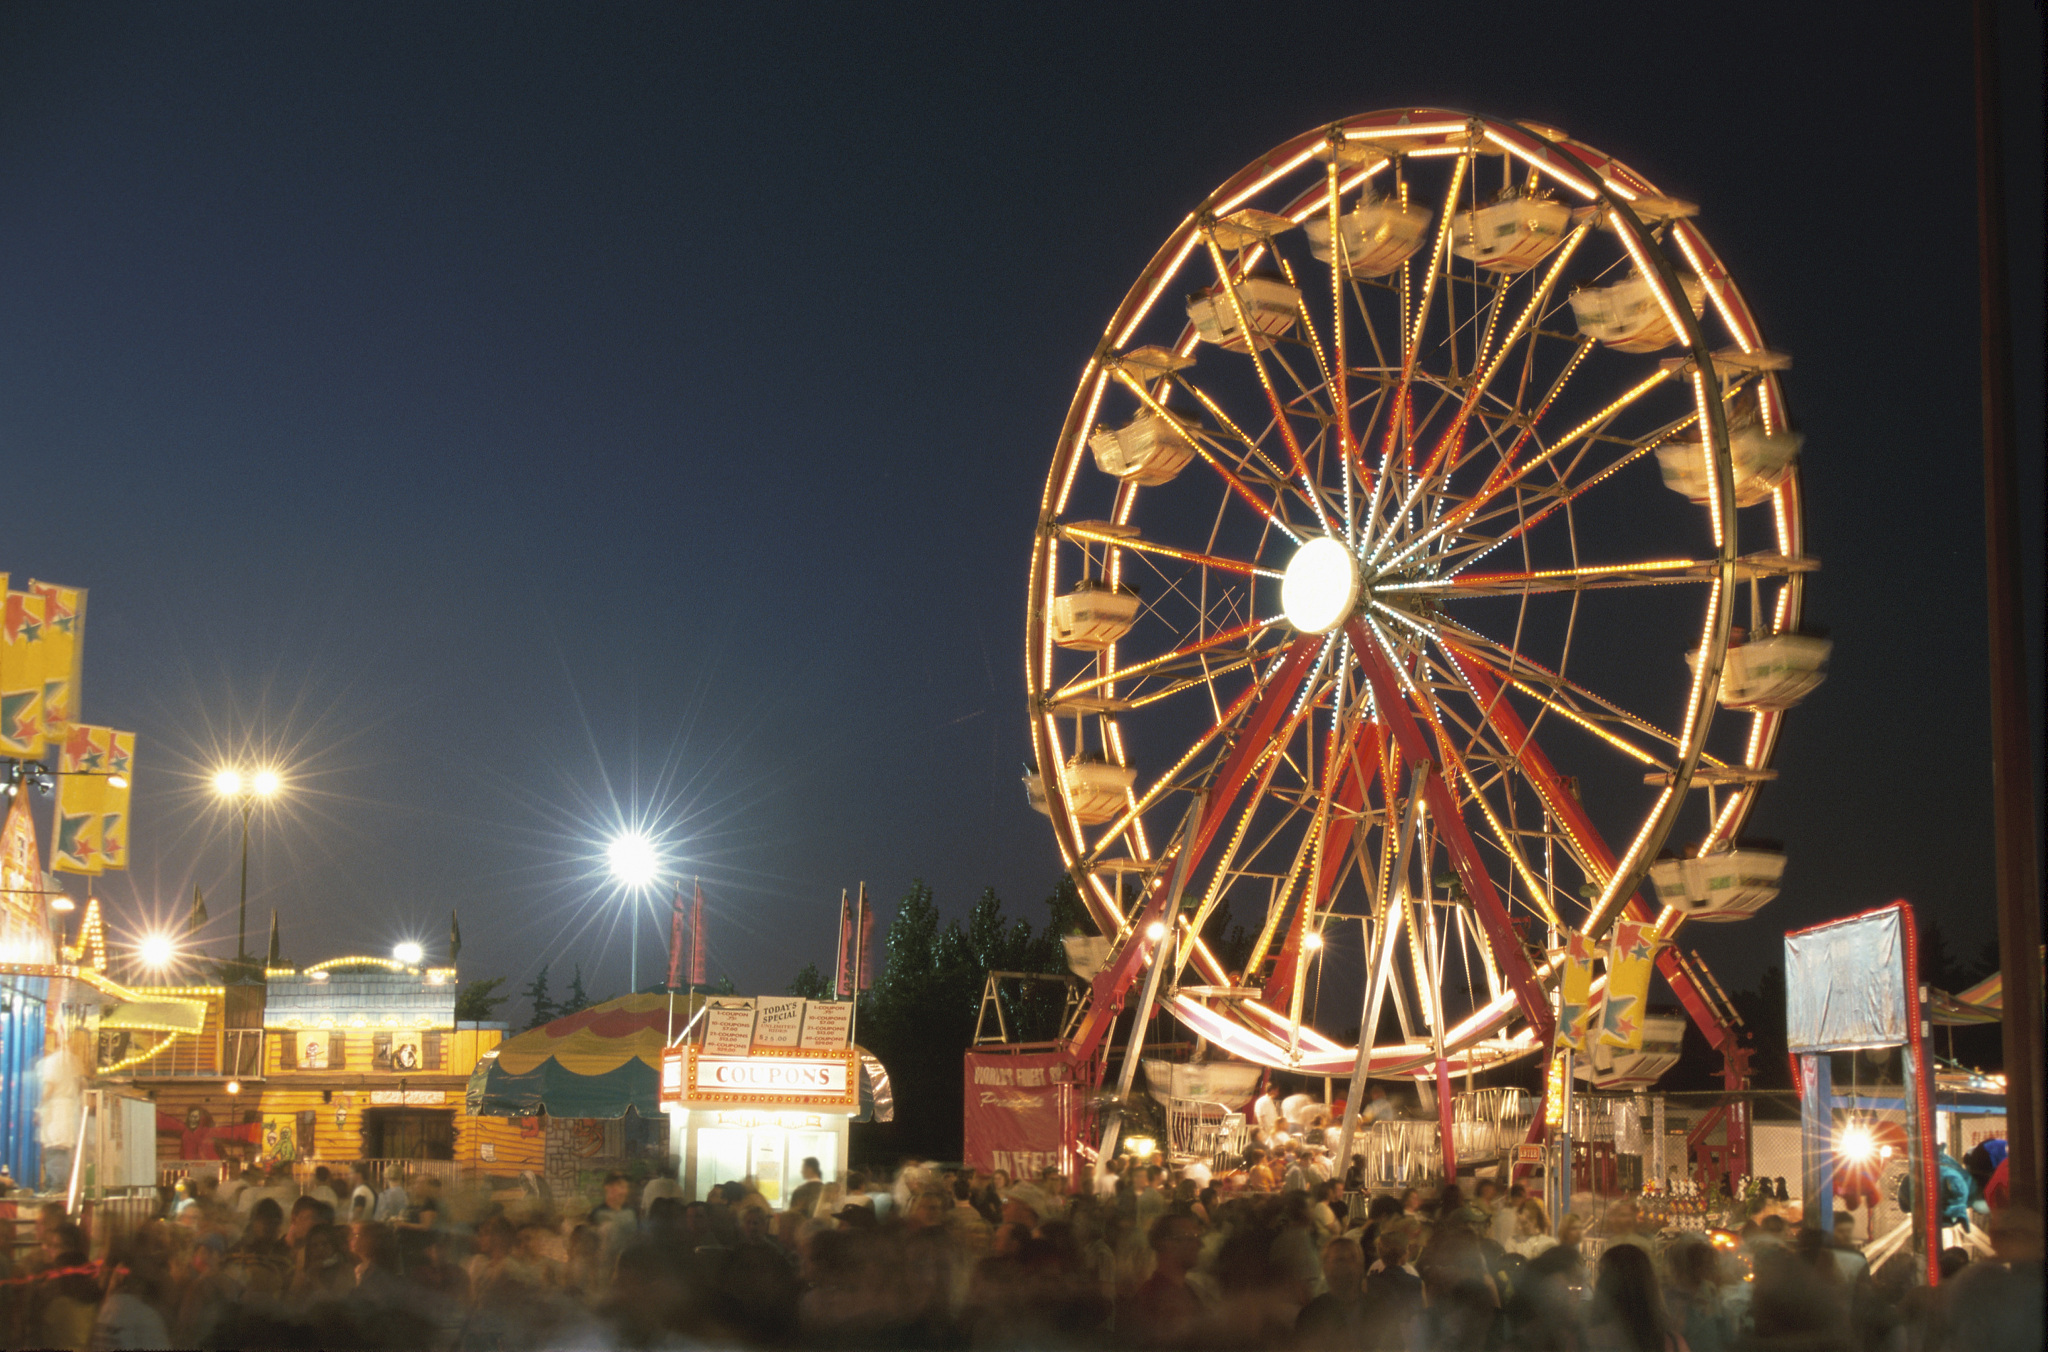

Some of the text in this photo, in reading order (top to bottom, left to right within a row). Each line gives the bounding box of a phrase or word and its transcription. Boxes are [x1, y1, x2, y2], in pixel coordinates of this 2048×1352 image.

[763, 1001, 797, 1015] TODAY'S
[763, 1010, 797, 1024] SPECIAL
[716, 1066, 830, 1085] COUPONS
